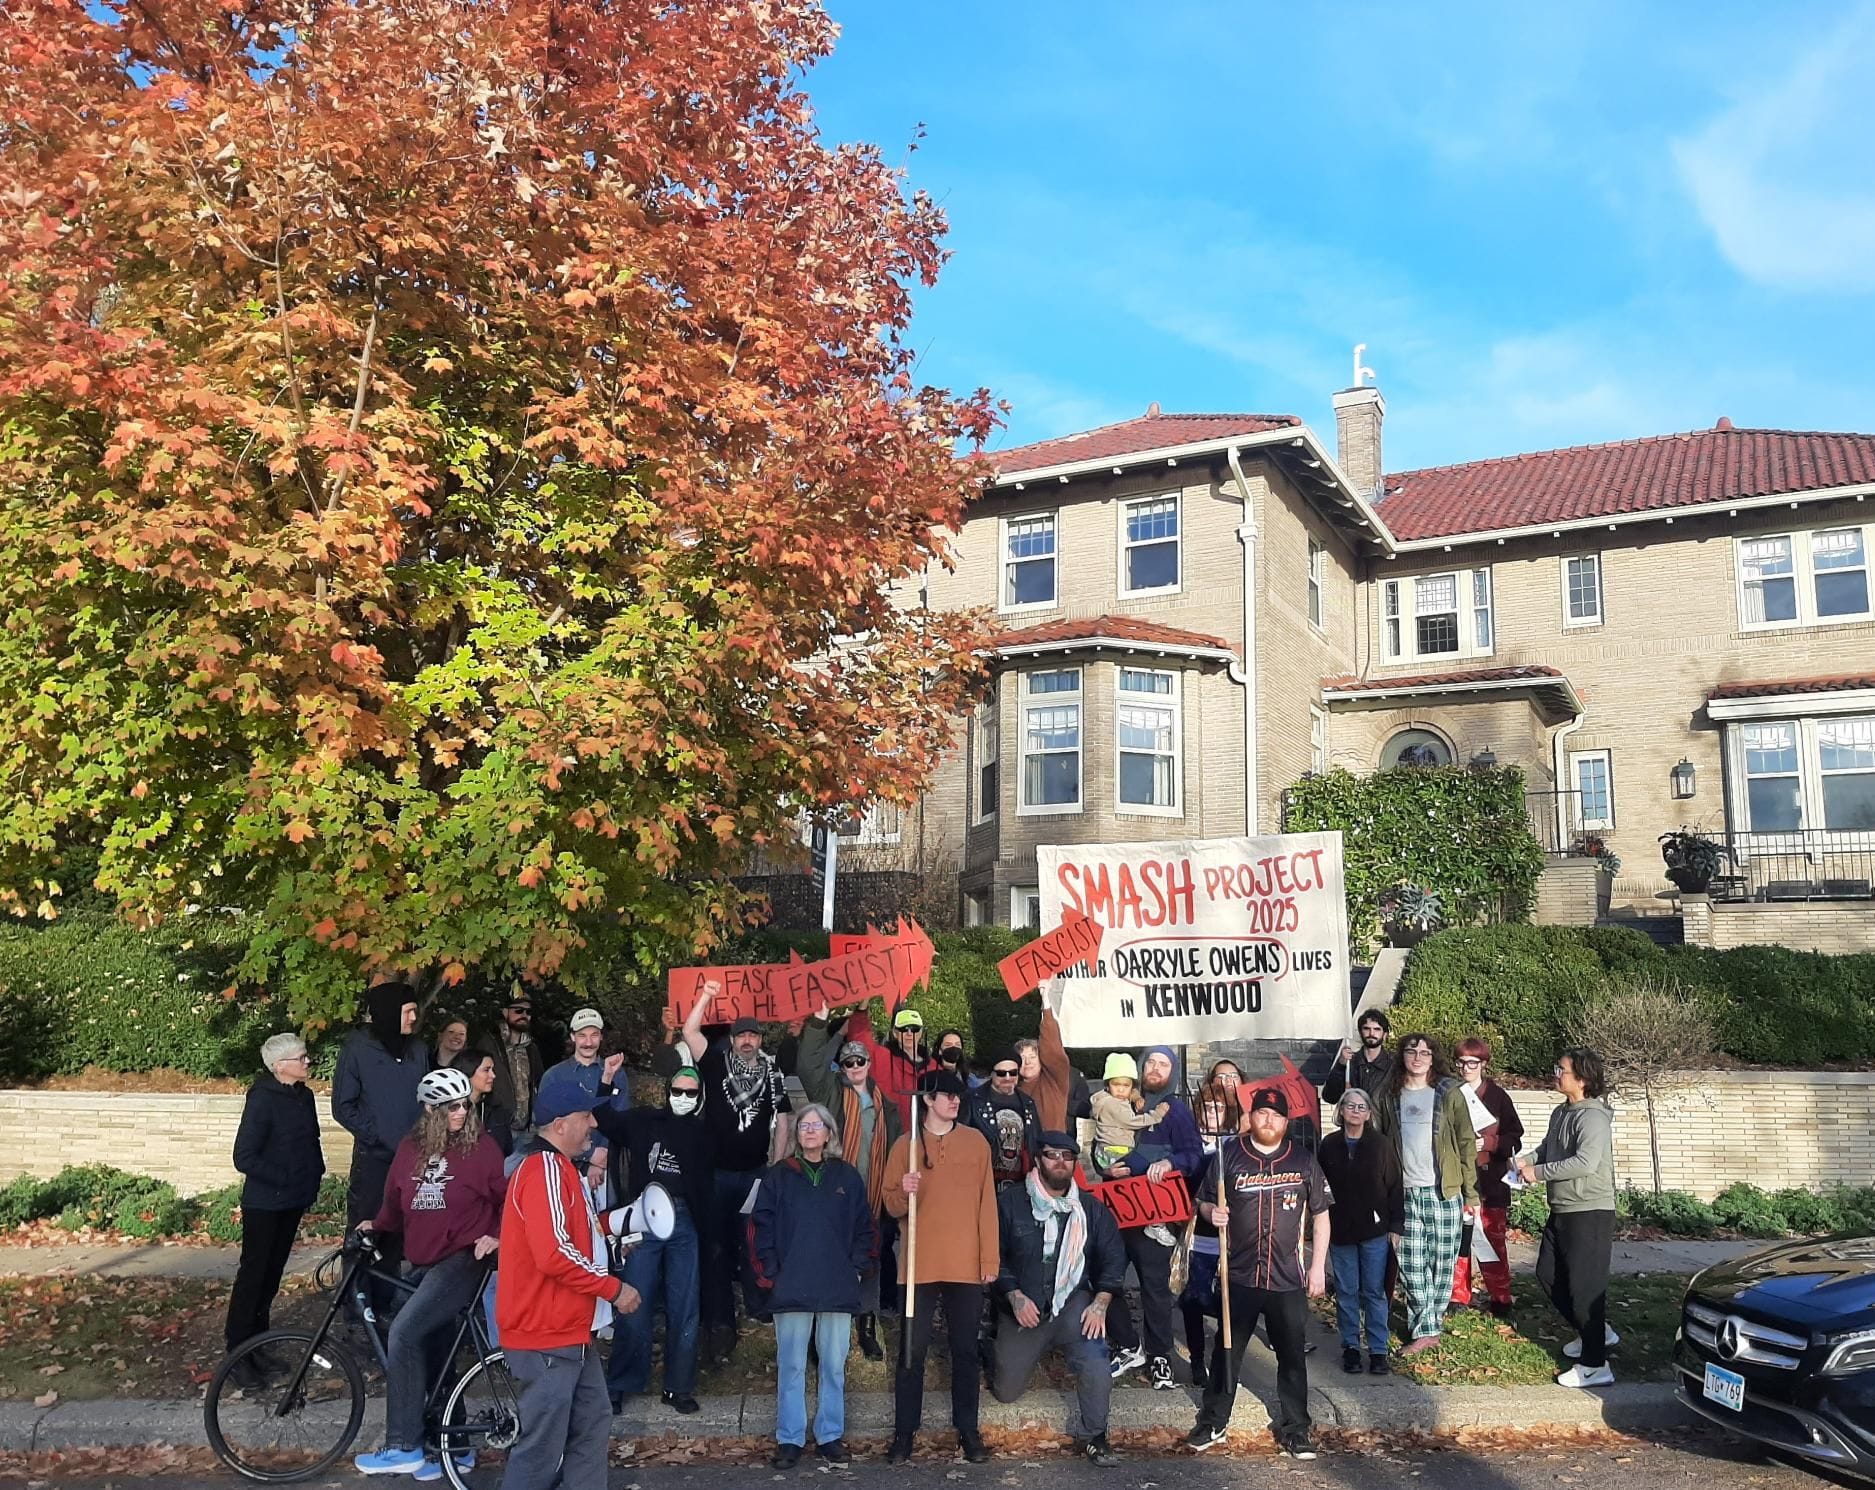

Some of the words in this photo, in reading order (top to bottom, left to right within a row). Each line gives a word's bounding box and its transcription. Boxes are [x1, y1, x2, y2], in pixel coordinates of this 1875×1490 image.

[1058, 859, 1196, 928] SMASH
[1203, 849, 1323, 901] PROJECT
[1246, 896, 1299, 934] 2025
[1014, 916, 1098, 987] FASCIST
[1114, 947, 1203, 979] DARRYLE
[1209, 942, 1280, 977] OWENS
[1292, 950, 1332, 972] LIVES
[694, 972, 706, 996] A
[725, 966, 794, 995] FASC
[788, 947, 897, 1013] FASCIST
[1121, 999, 1135, 1018] IN
[1145, 980, 1263, 1018] KENWOOD
[676, 996, 740, 1025] LVES
[1088, 1175, 1190, 1223] ASCIST
